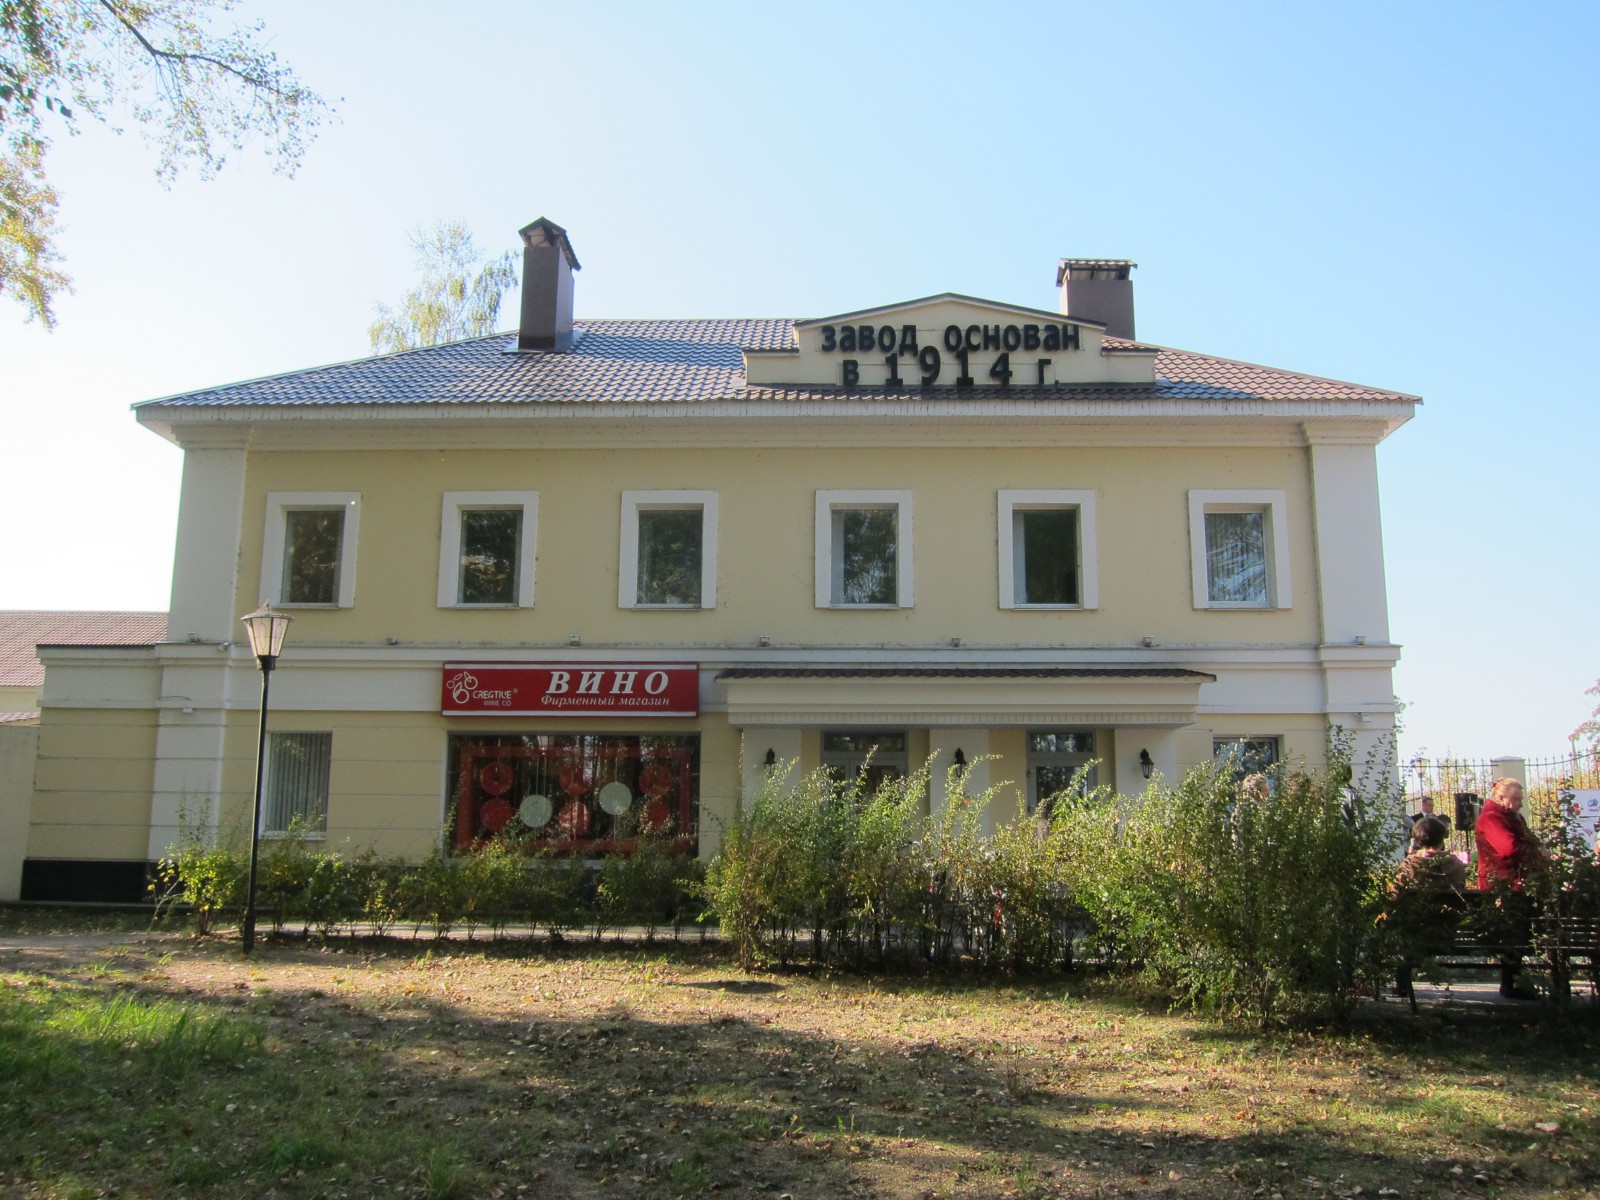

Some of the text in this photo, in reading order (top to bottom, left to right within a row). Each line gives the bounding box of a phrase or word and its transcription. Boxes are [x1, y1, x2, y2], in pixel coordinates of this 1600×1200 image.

[885, 345, 1013, 386] 1914
[545, 671, 669, 695] ВИНО
[541, 695, 670, 708] Фирменный магазин
